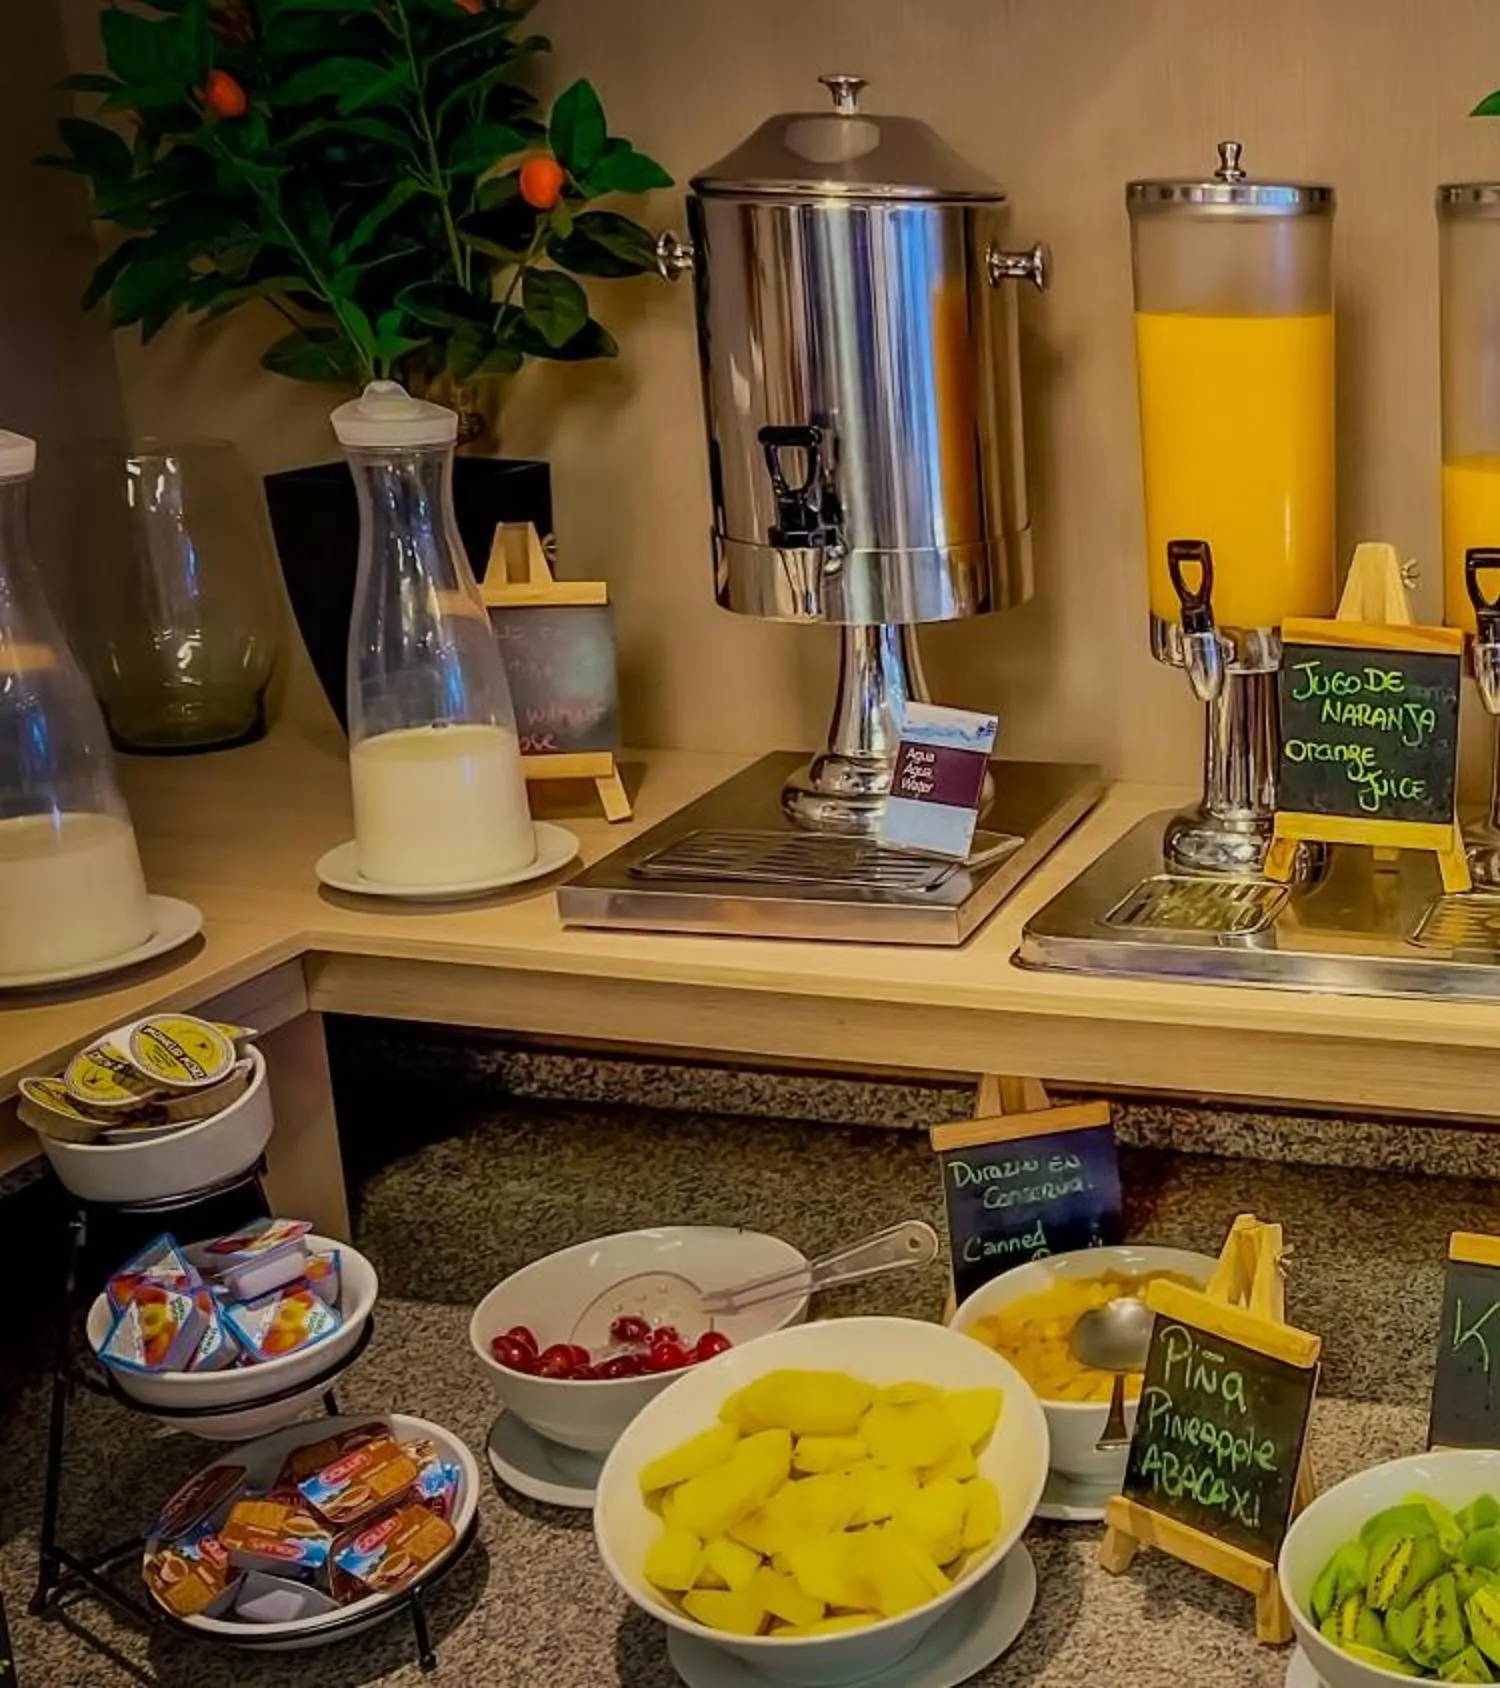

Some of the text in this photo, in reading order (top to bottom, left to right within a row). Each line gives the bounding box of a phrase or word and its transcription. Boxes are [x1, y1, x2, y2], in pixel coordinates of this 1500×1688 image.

[1321, 698, 1436, 747] NARANJA
[901, 777, 934, 793] Water
[963, 1220, 1047, 1263] Canned
